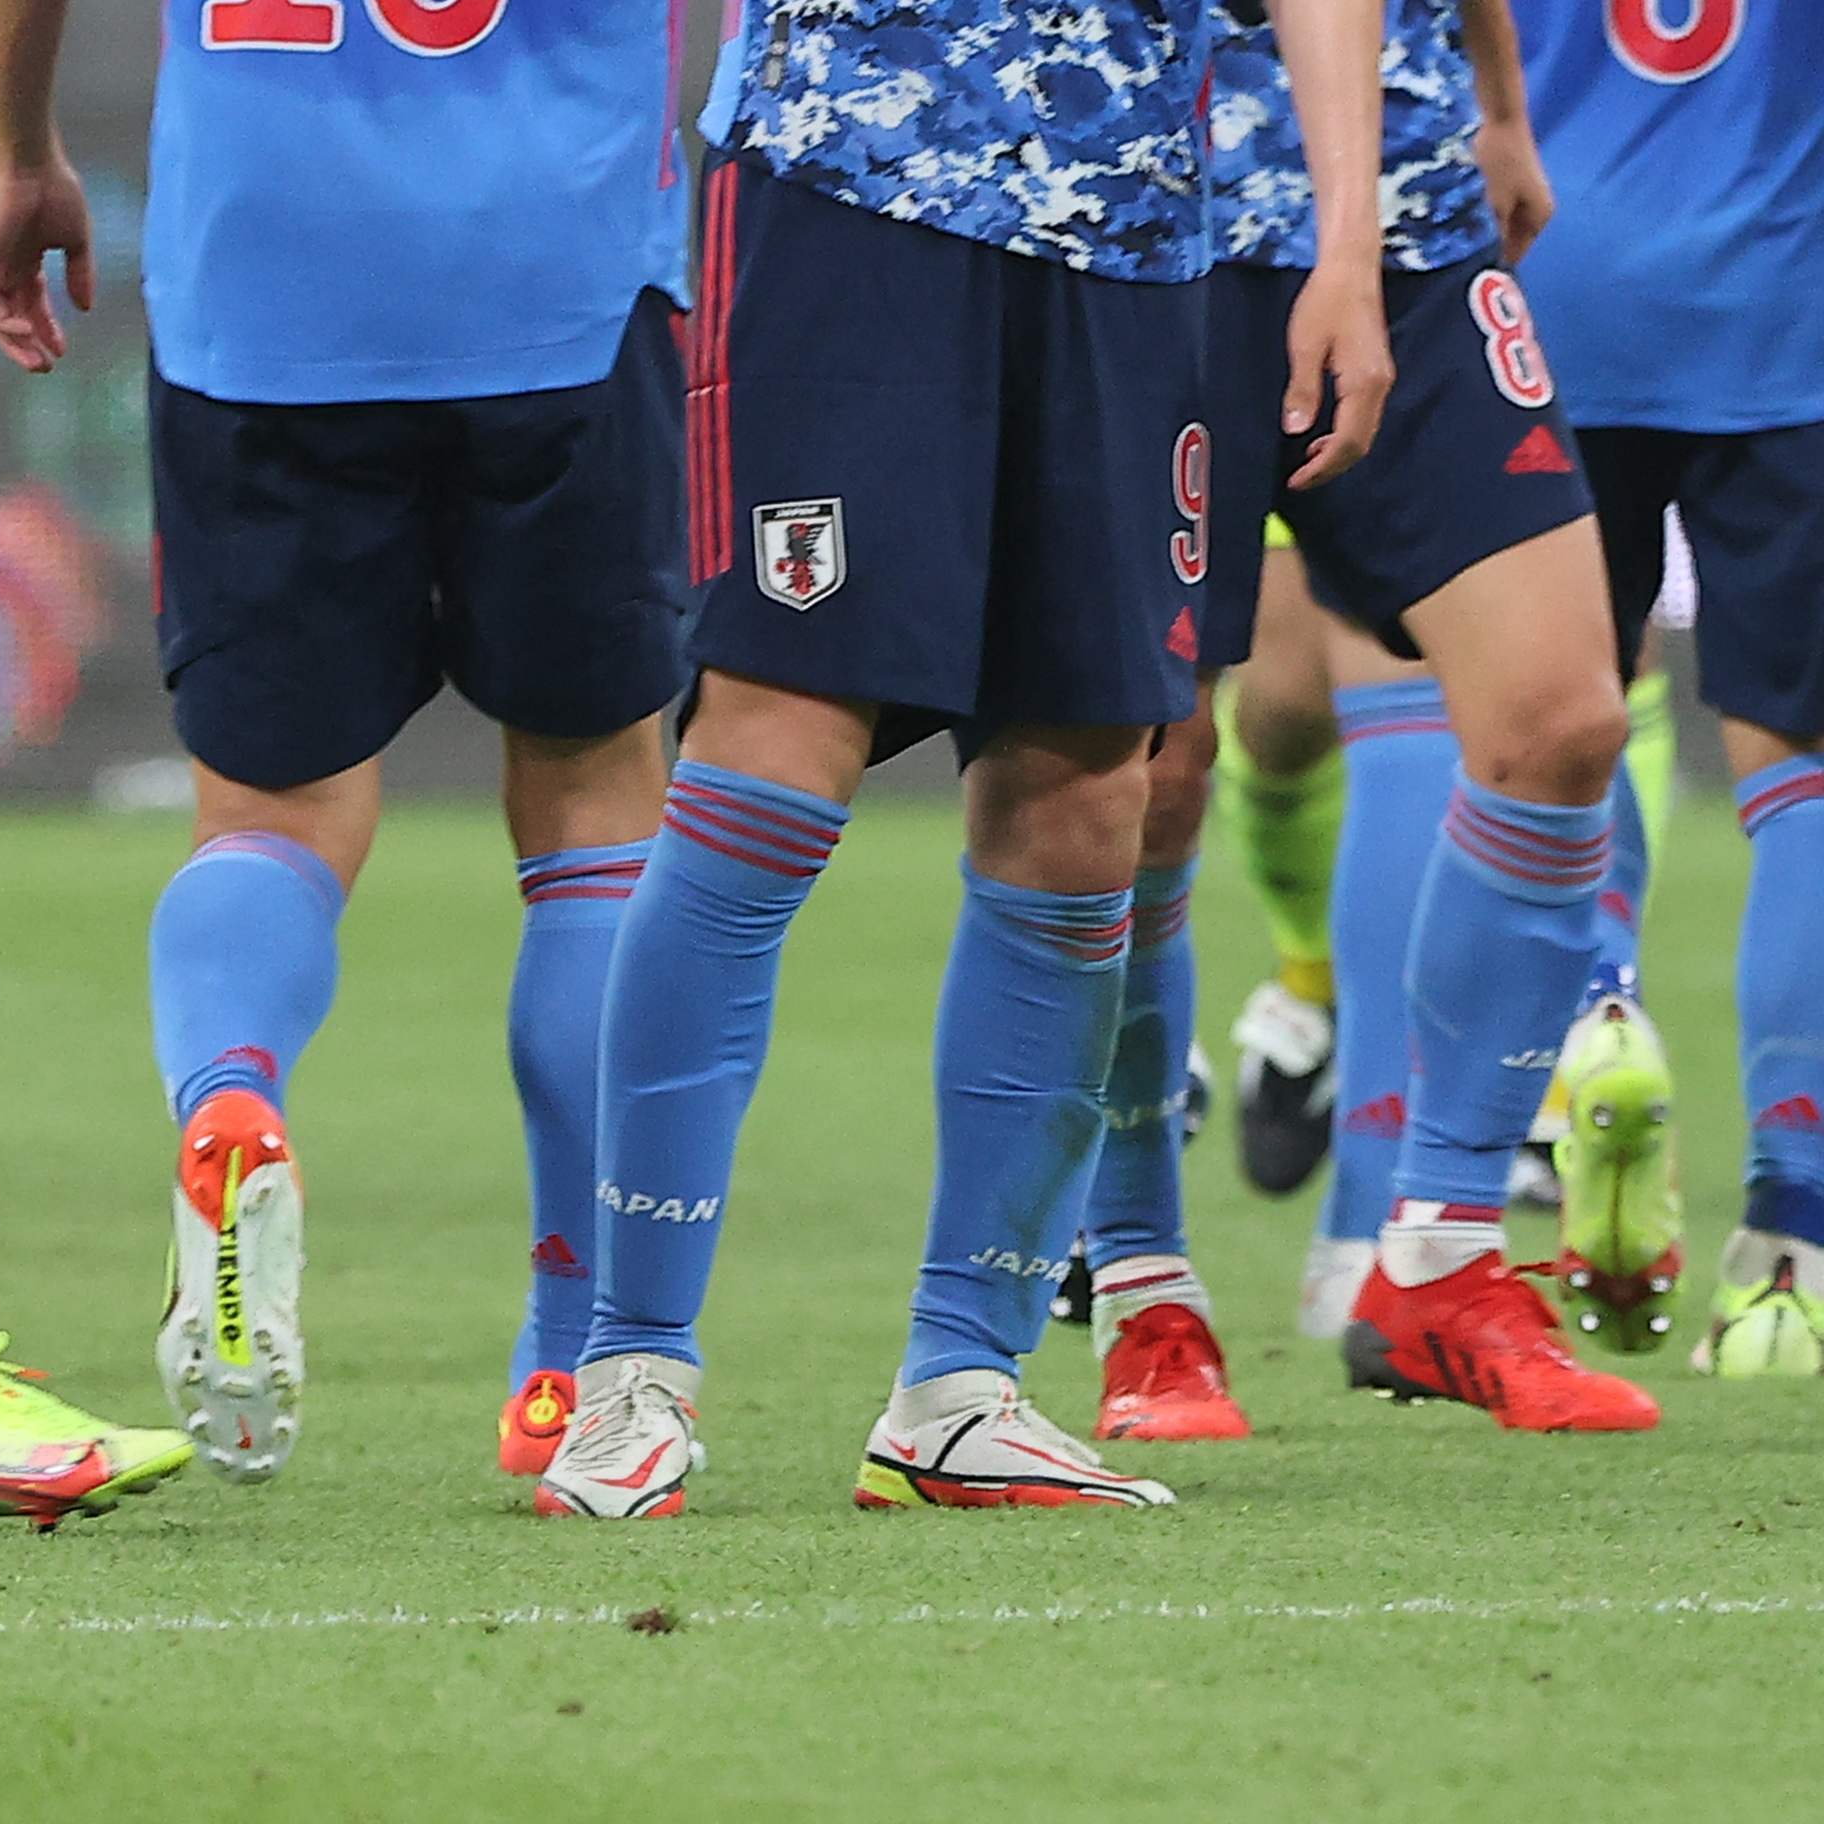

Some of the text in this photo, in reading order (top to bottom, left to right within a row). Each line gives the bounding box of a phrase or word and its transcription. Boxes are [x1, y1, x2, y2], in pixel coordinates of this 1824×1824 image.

[1467, 268, 1554, 409] 8
[1171, 422, 1212, 586] 9
[969, 1246, 1073, 1283] JAPA
